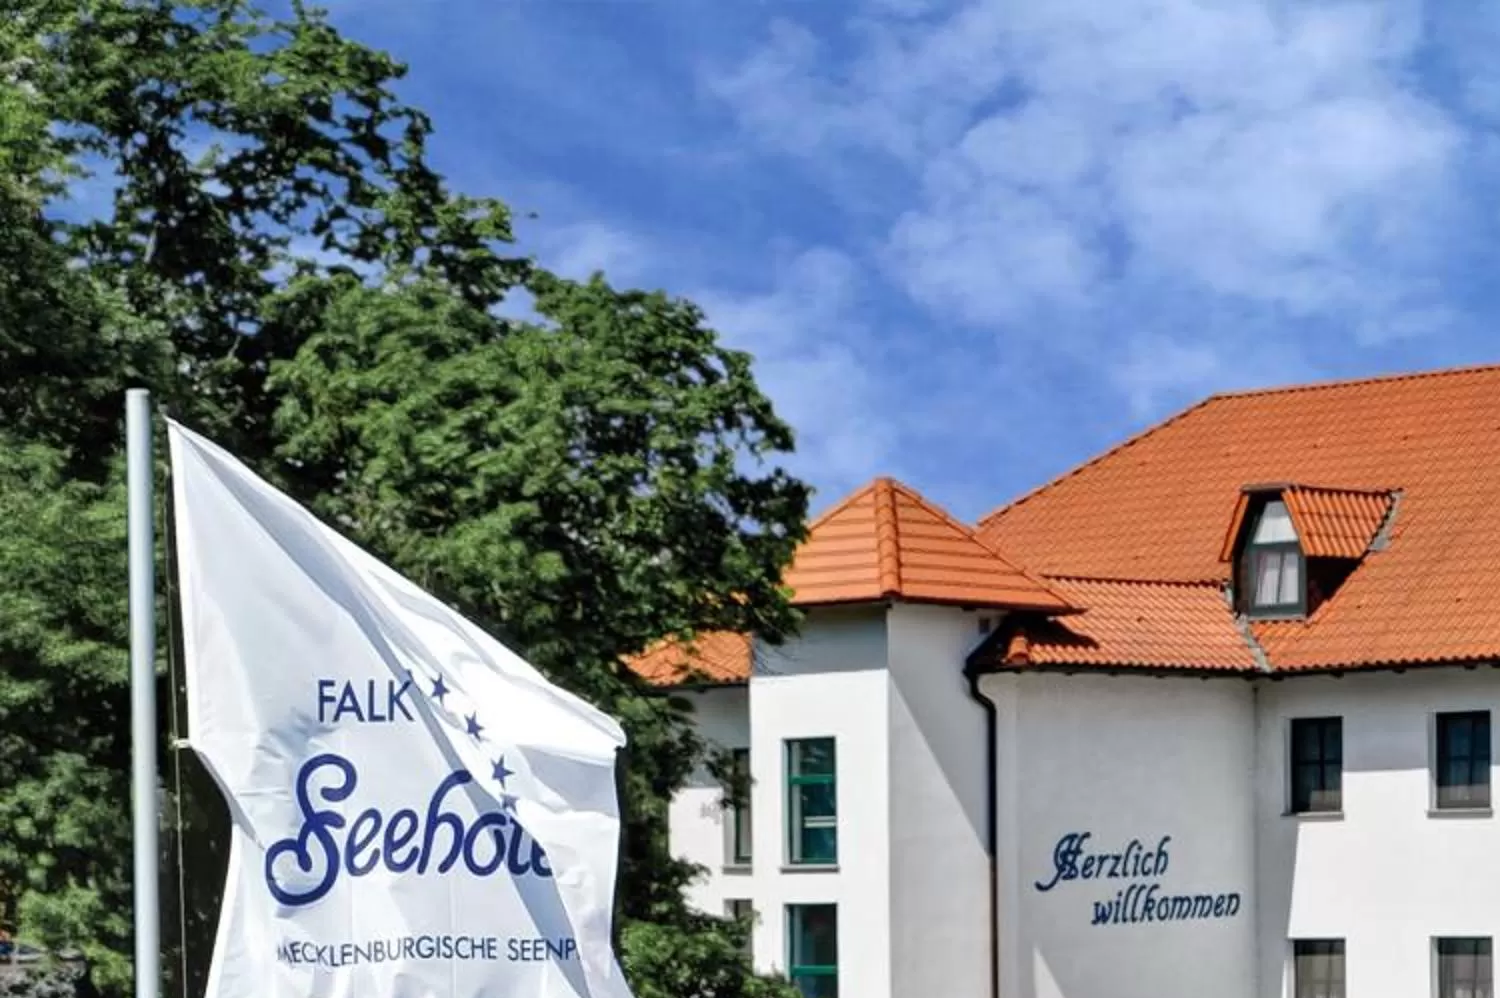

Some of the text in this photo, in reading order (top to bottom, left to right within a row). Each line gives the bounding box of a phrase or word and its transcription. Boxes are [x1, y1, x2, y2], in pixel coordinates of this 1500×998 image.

[318, 679, 415, 722] FALK
[1034, 831, 1171, 892] Herzlich
[1090, 883, 1241, 926] willkommen
[507, 938, 580, 962] SEENP
